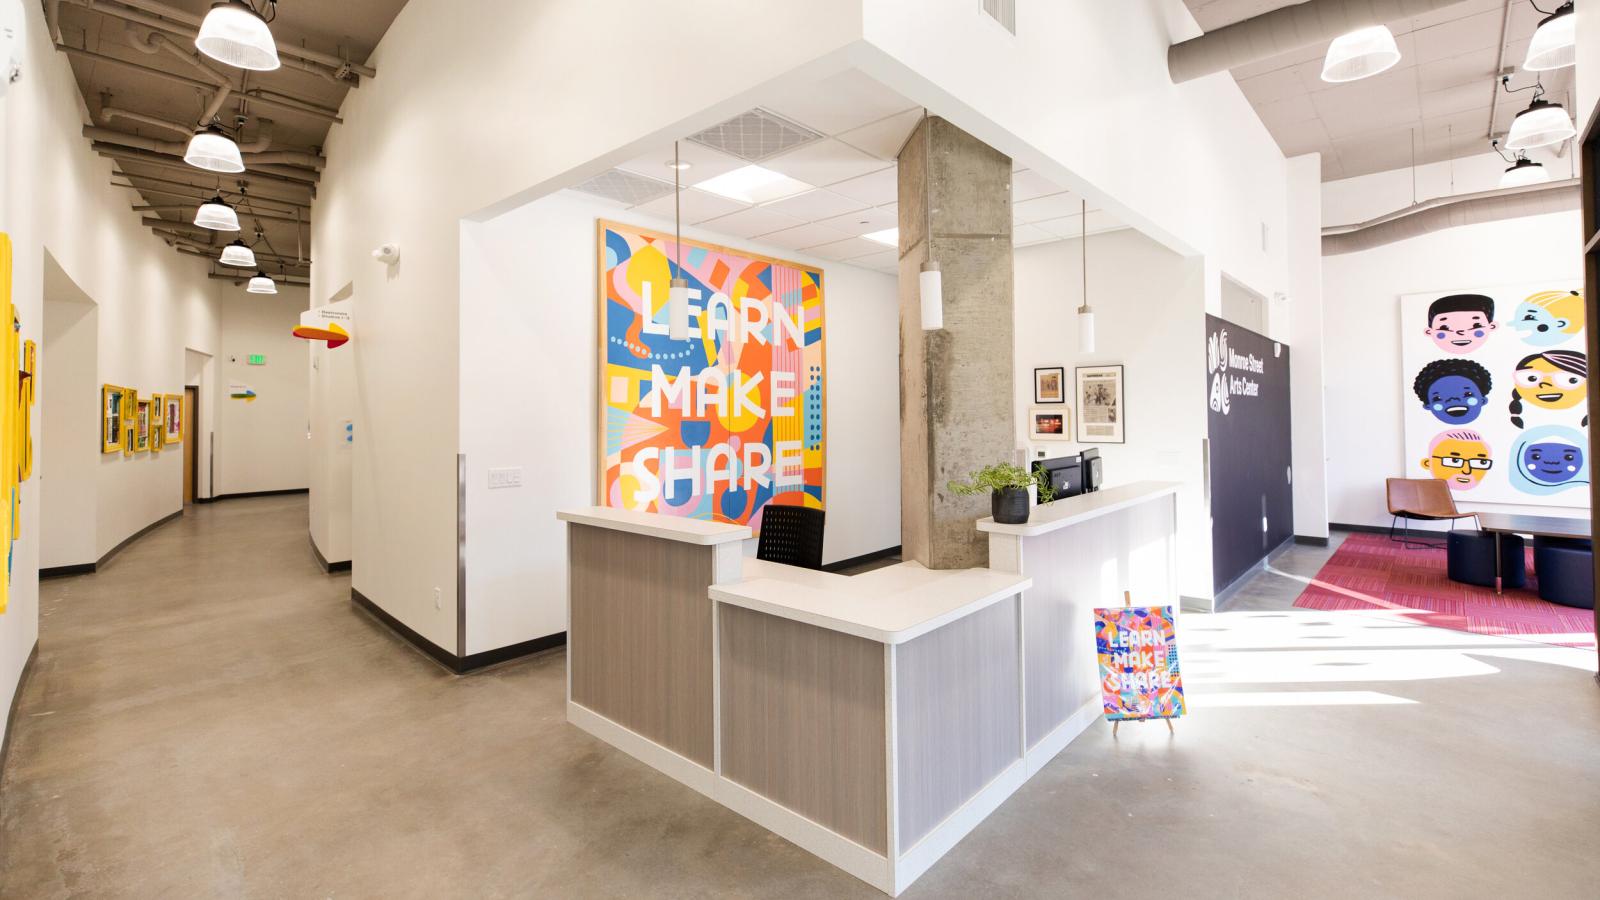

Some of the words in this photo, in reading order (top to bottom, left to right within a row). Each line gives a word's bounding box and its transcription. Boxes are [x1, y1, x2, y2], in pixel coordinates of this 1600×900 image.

[1229, 347, 1248, 371] Monroe
[1249, 353, 1263, 374] Street
[651, 364, 795, 420] MAKE
[1230, 374, 1242, 395] Arts
[1242, 376, 1259, 396] Center
[632, 440, 804, 503] SHARE
[1108, 629, 1166, 648] LEARN
[1113, 651, 1165, 668] MAKE
